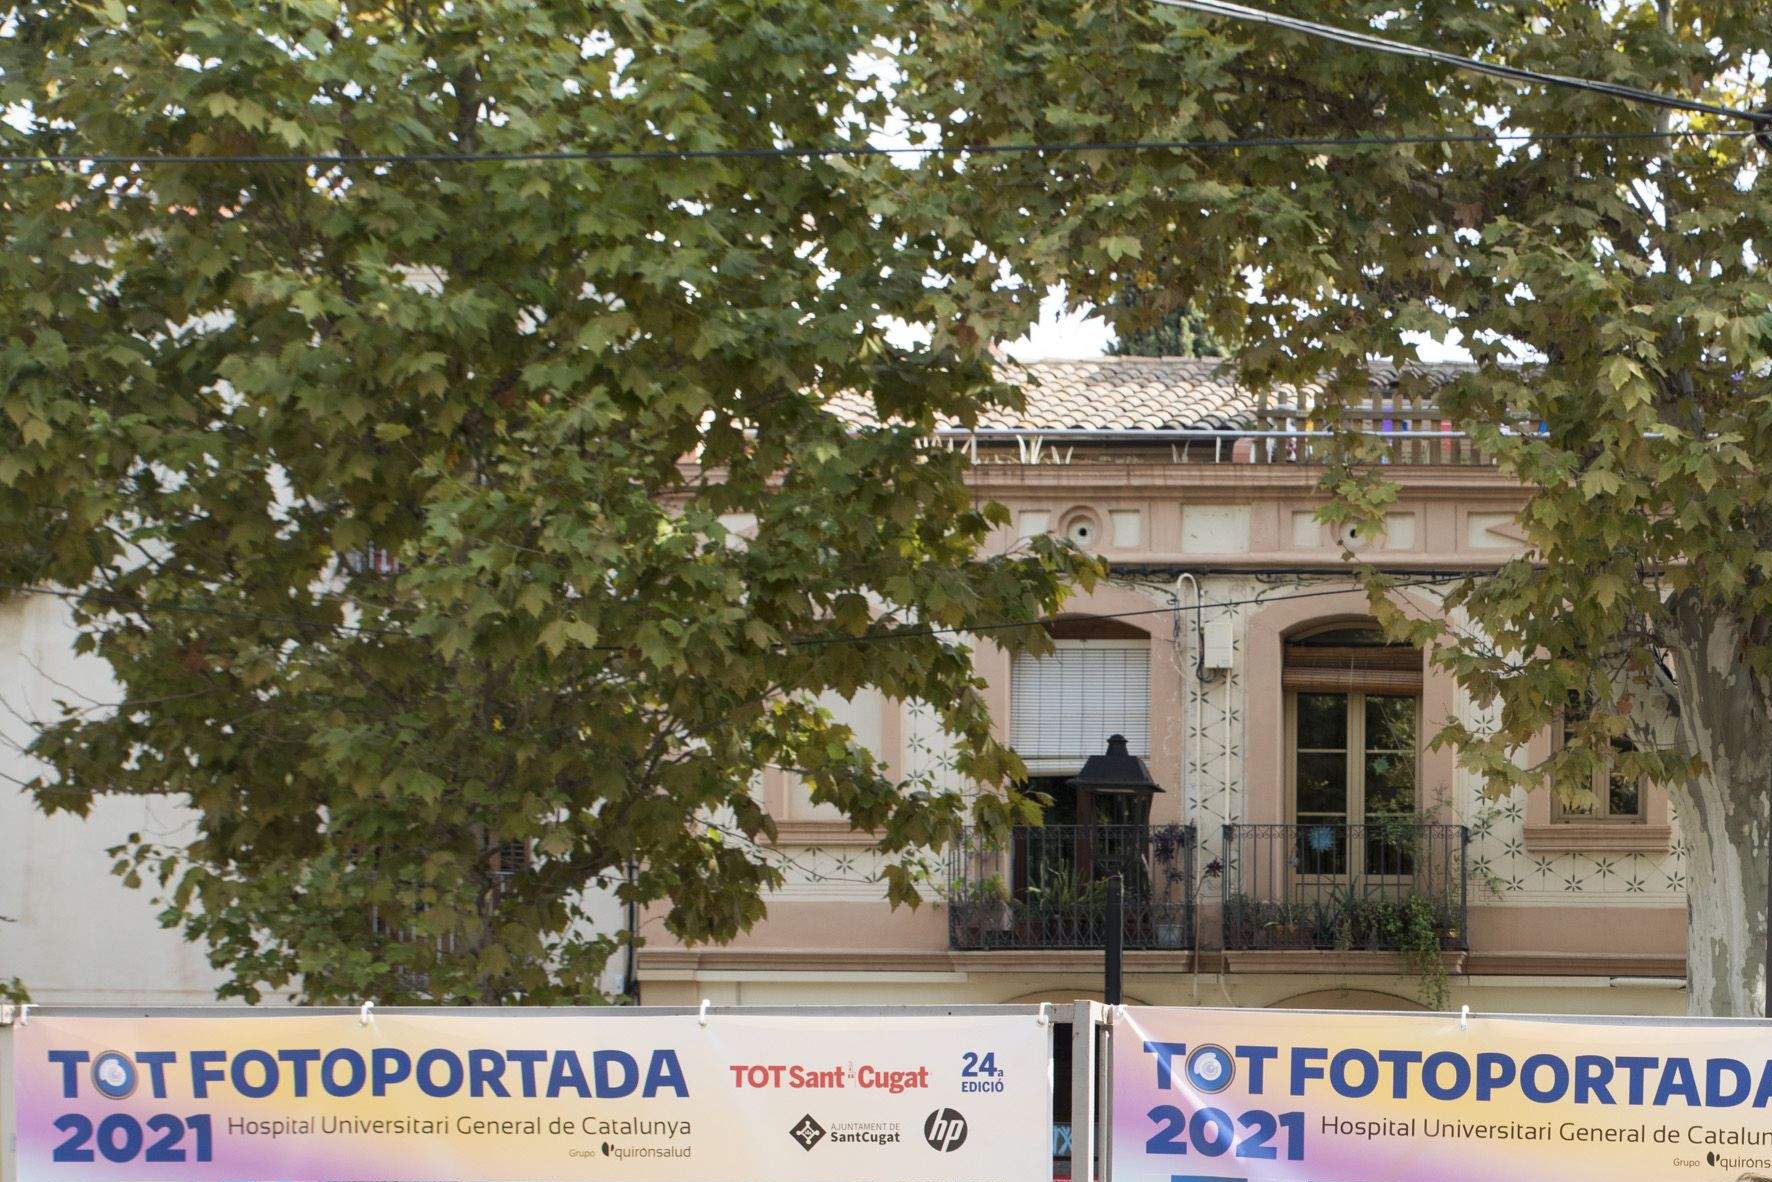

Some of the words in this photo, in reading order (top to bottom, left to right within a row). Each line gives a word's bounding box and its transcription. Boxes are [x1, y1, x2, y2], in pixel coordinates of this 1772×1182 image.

[190, 1048, 691, 1099] FOTOPORTADA
[730, 1065, 787, 1089] TOT
[858, 1065, 930, 1095] Cugat
[961, 1079, 1004, 1093] EDICIÓ
[53, 1112, 213, 1164] 2021
[228, 1115, 315, 1140] Hospital
[321, 1115, 449, 1136] Universitari
[457, 1115, 542, 1135] General
[549, 1116, 575, 1135] de
[583, 1115, 692, 1140] Catalunya
[831, 1122, 888, 1132] AJUNTAMENT
[890, 1122, 901, 1132] DE
[831, 1131, 901, 1146] SantCugat
[926, 1108, 967, 1153] hp
[1146, 1104, 1305, 1161] 2021
[1321, 1115, 1415, 1140] Hospital
[1423, 1118, 1552, 1142] Universitari
[1560, 1122, 1645, 1146] General
[1653, 1126, 1681, 1147] de
[569, 1149, 596, 1160] Grupo
[1672, 1157, 1700, 1169] Grupo
